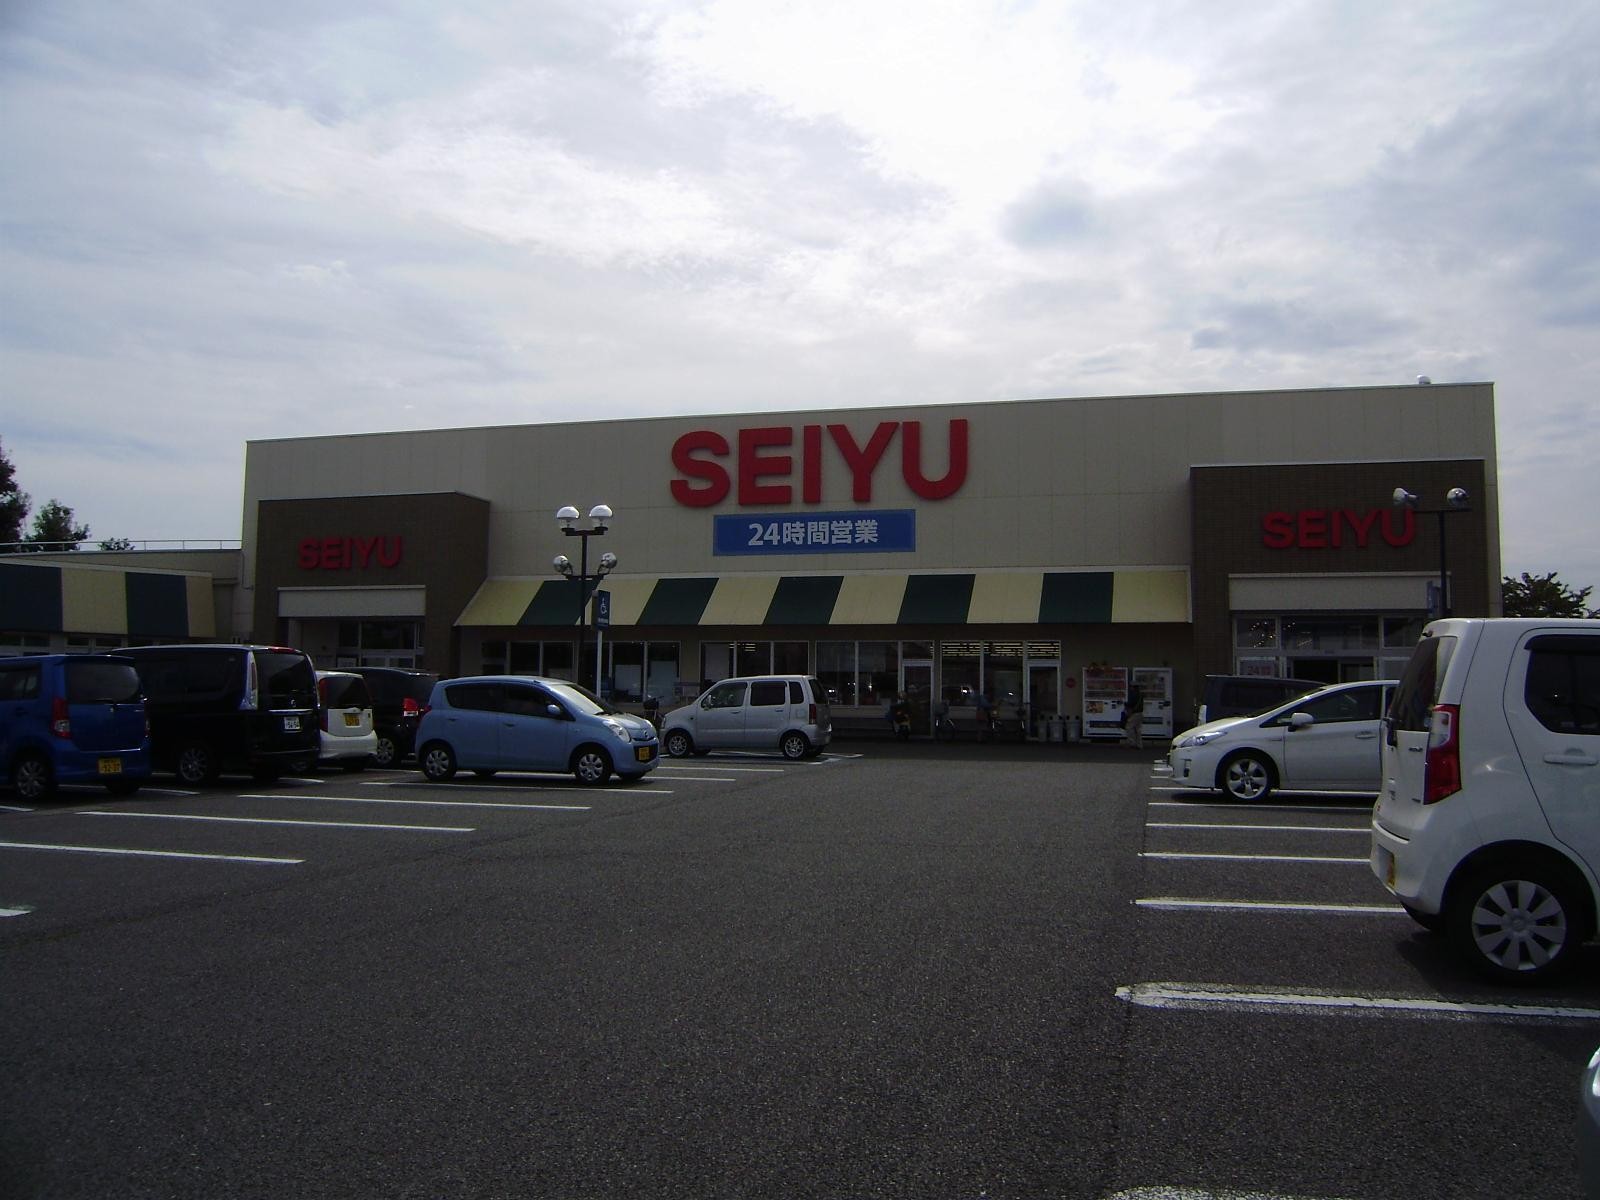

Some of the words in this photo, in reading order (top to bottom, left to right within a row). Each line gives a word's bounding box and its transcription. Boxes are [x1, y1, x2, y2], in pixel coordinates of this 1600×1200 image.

[670, 419, 968, 508] SEIYU
[748, 519, 880, 546] 24時間営業
[1263, 508, 1416, 549] SEIYU
[299, 536, 402, 570] SEIYU
